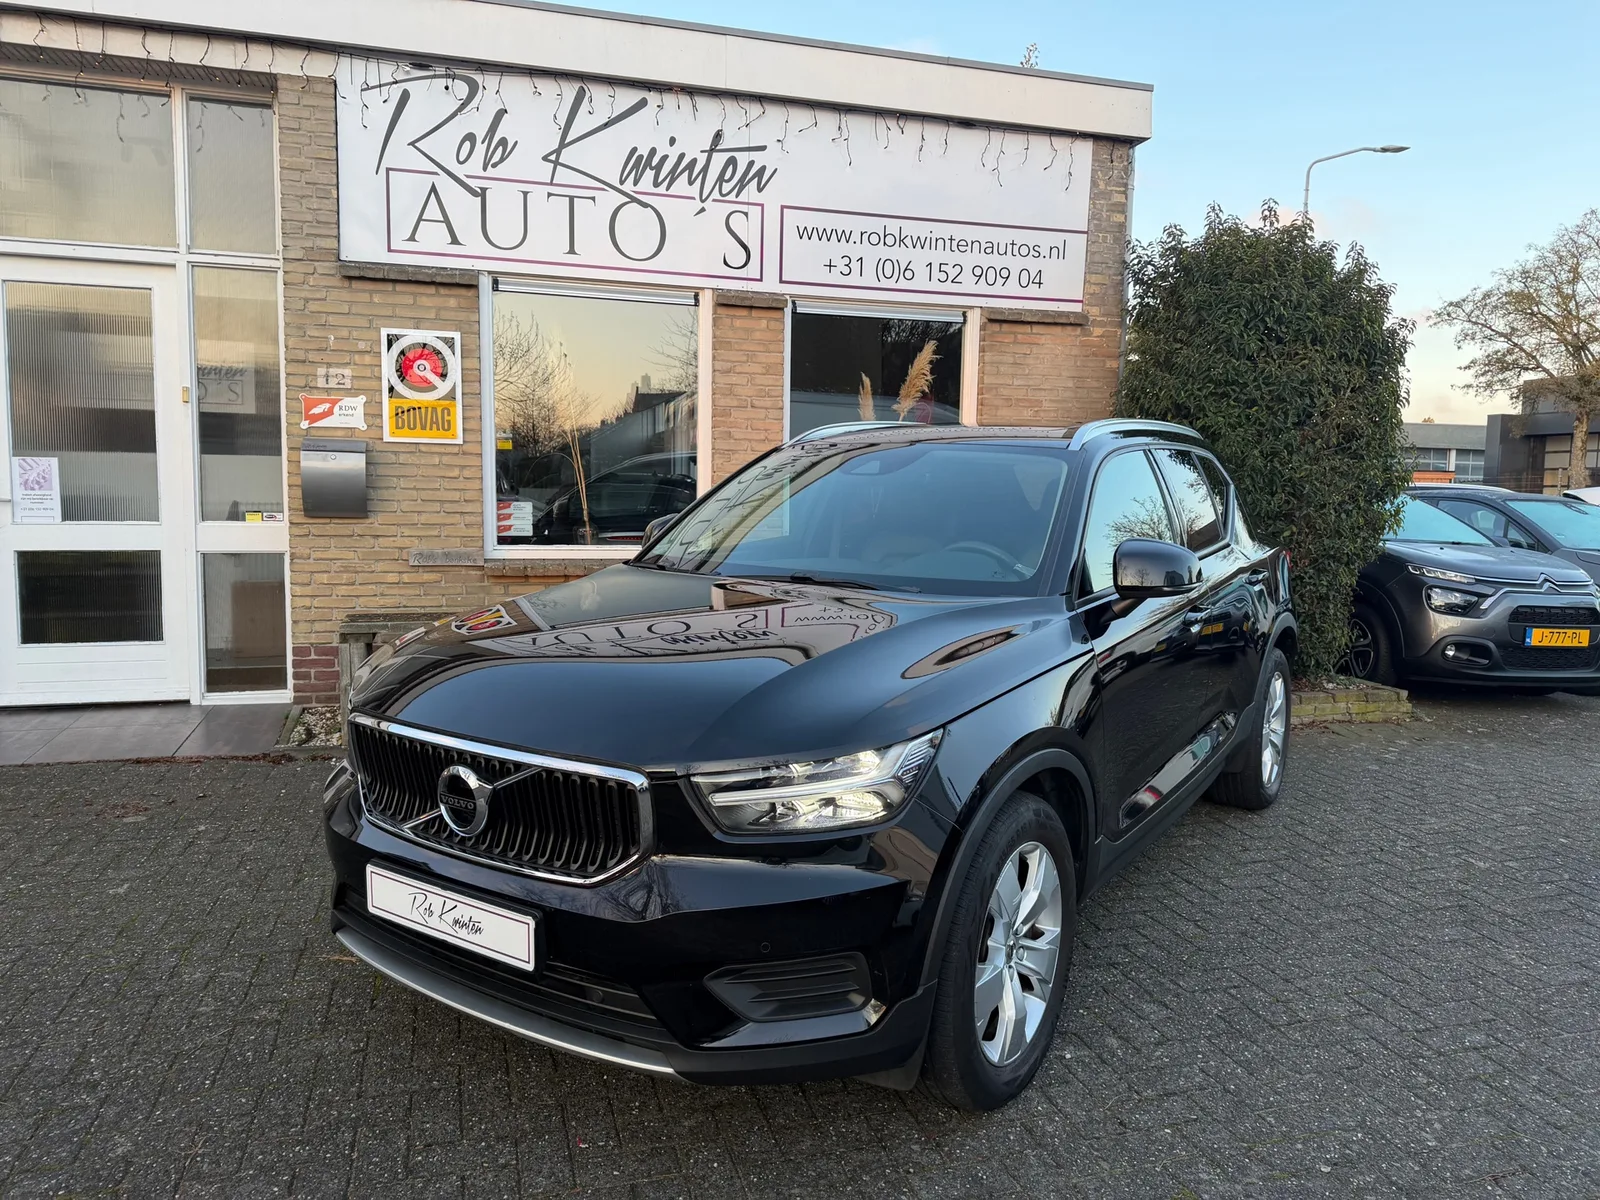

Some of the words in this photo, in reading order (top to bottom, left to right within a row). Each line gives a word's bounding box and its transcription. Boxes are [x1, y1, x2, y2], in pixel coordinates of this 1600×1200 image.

[361, 74, 519, 198] Rob
[542, 85, 778, 208] Kwinten
[796, 224, 1067, 260] www.robkwintenautos.nl
[823, 255, 864, 277] +31
[875, 257, 915, 284] (0)6
[925, 261, 963, 284] 152
[971, 265, 1011, 287] 909
[1018, 267, 1043, 289] 04
[338, 404, 358, 412] RDW
[395, 405, 452, 432] BOVAG
[1538, 631, 1583, 644] J-777-PL
[440, 794, 474, 809] VOLVO
[408, 891, 435, 925] Rob
[438, 899, 485, 936] Kwinten
